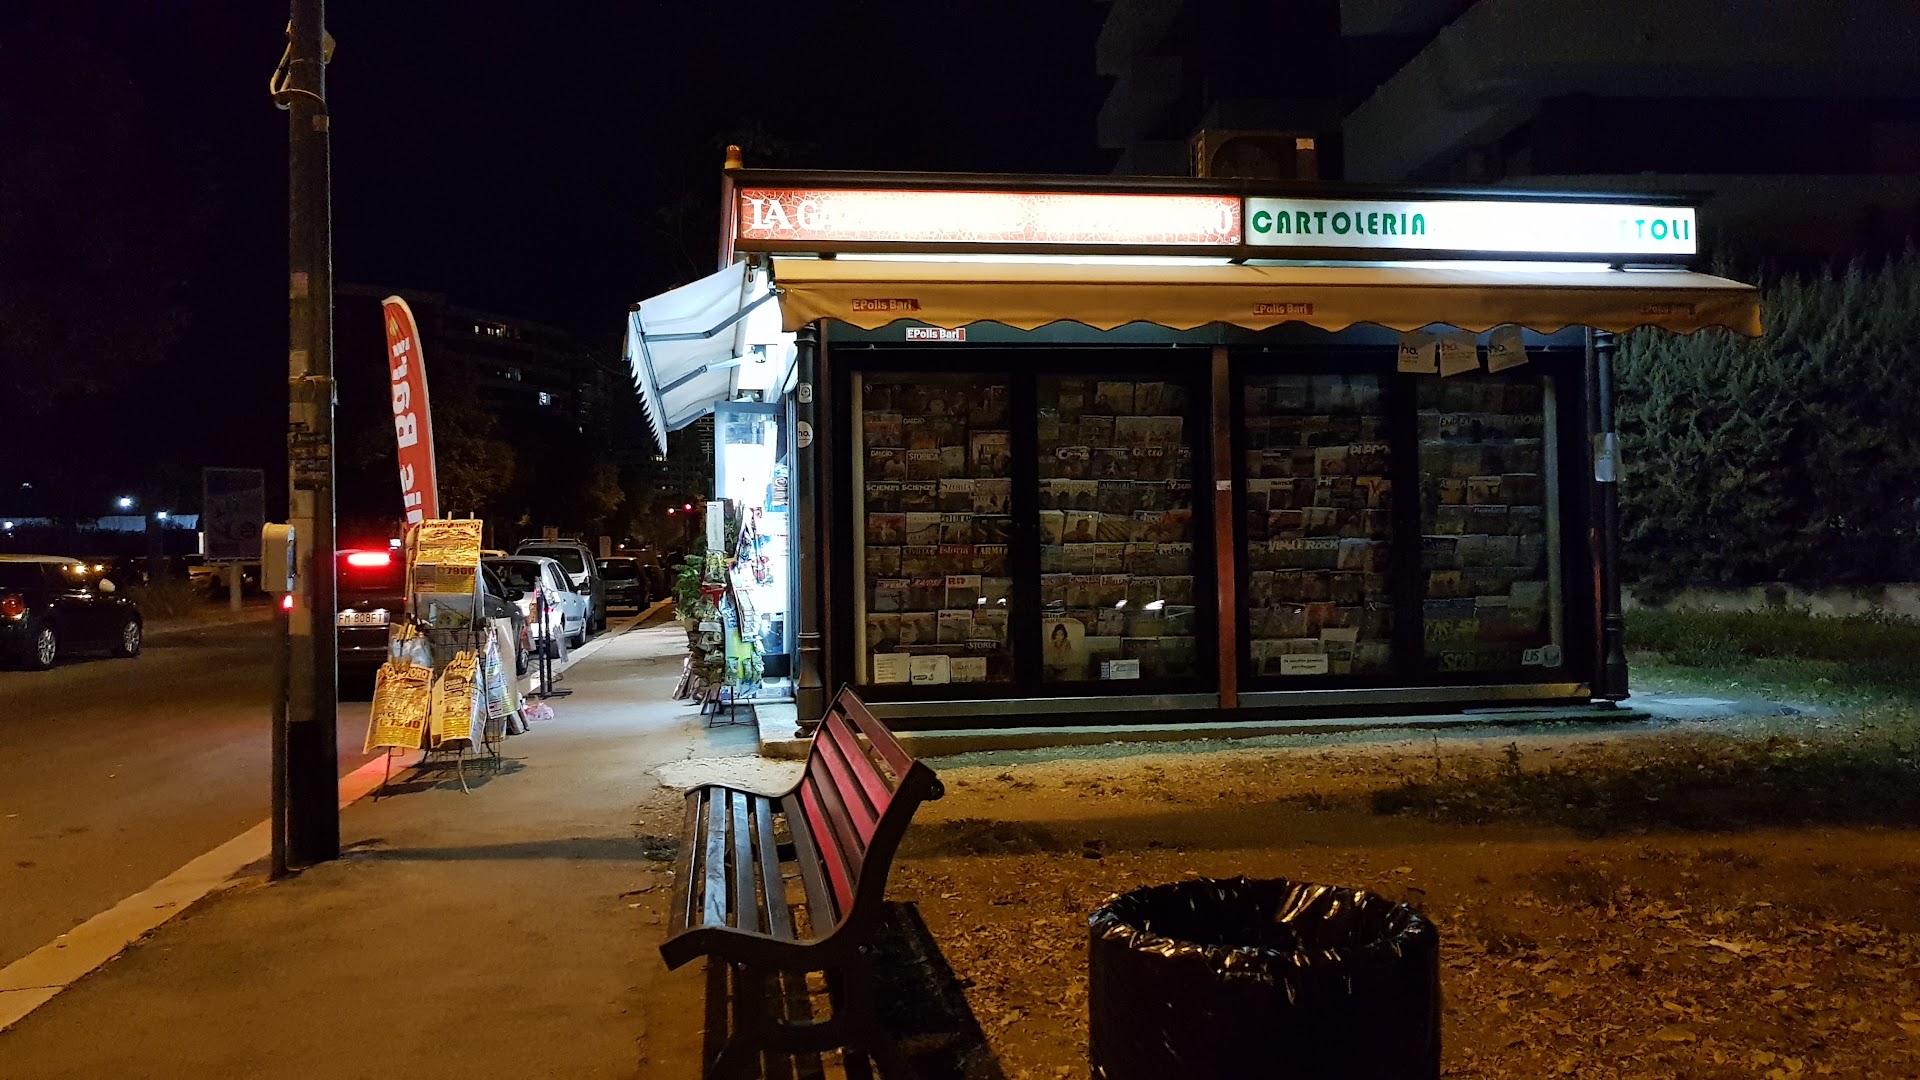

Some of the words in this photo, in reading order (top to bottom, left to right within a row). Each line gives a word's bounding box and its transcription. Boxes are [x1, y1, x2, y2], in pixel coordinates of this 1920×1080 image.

[749, 199, 793, 230] LA
[1252, 210, 1426, 236] CARTOLERIA
[853, 299, 888, 310] EPolis
[889, 299, 912, 310] Bari
[1253, 303, 1285, 314] EPolis
[1287, 303, 1307, 314] Bari
[907, 328, 938, 340] EPolis
[940, 328, 959, 340] Bari
[392, 337, 418, 449] Bari
